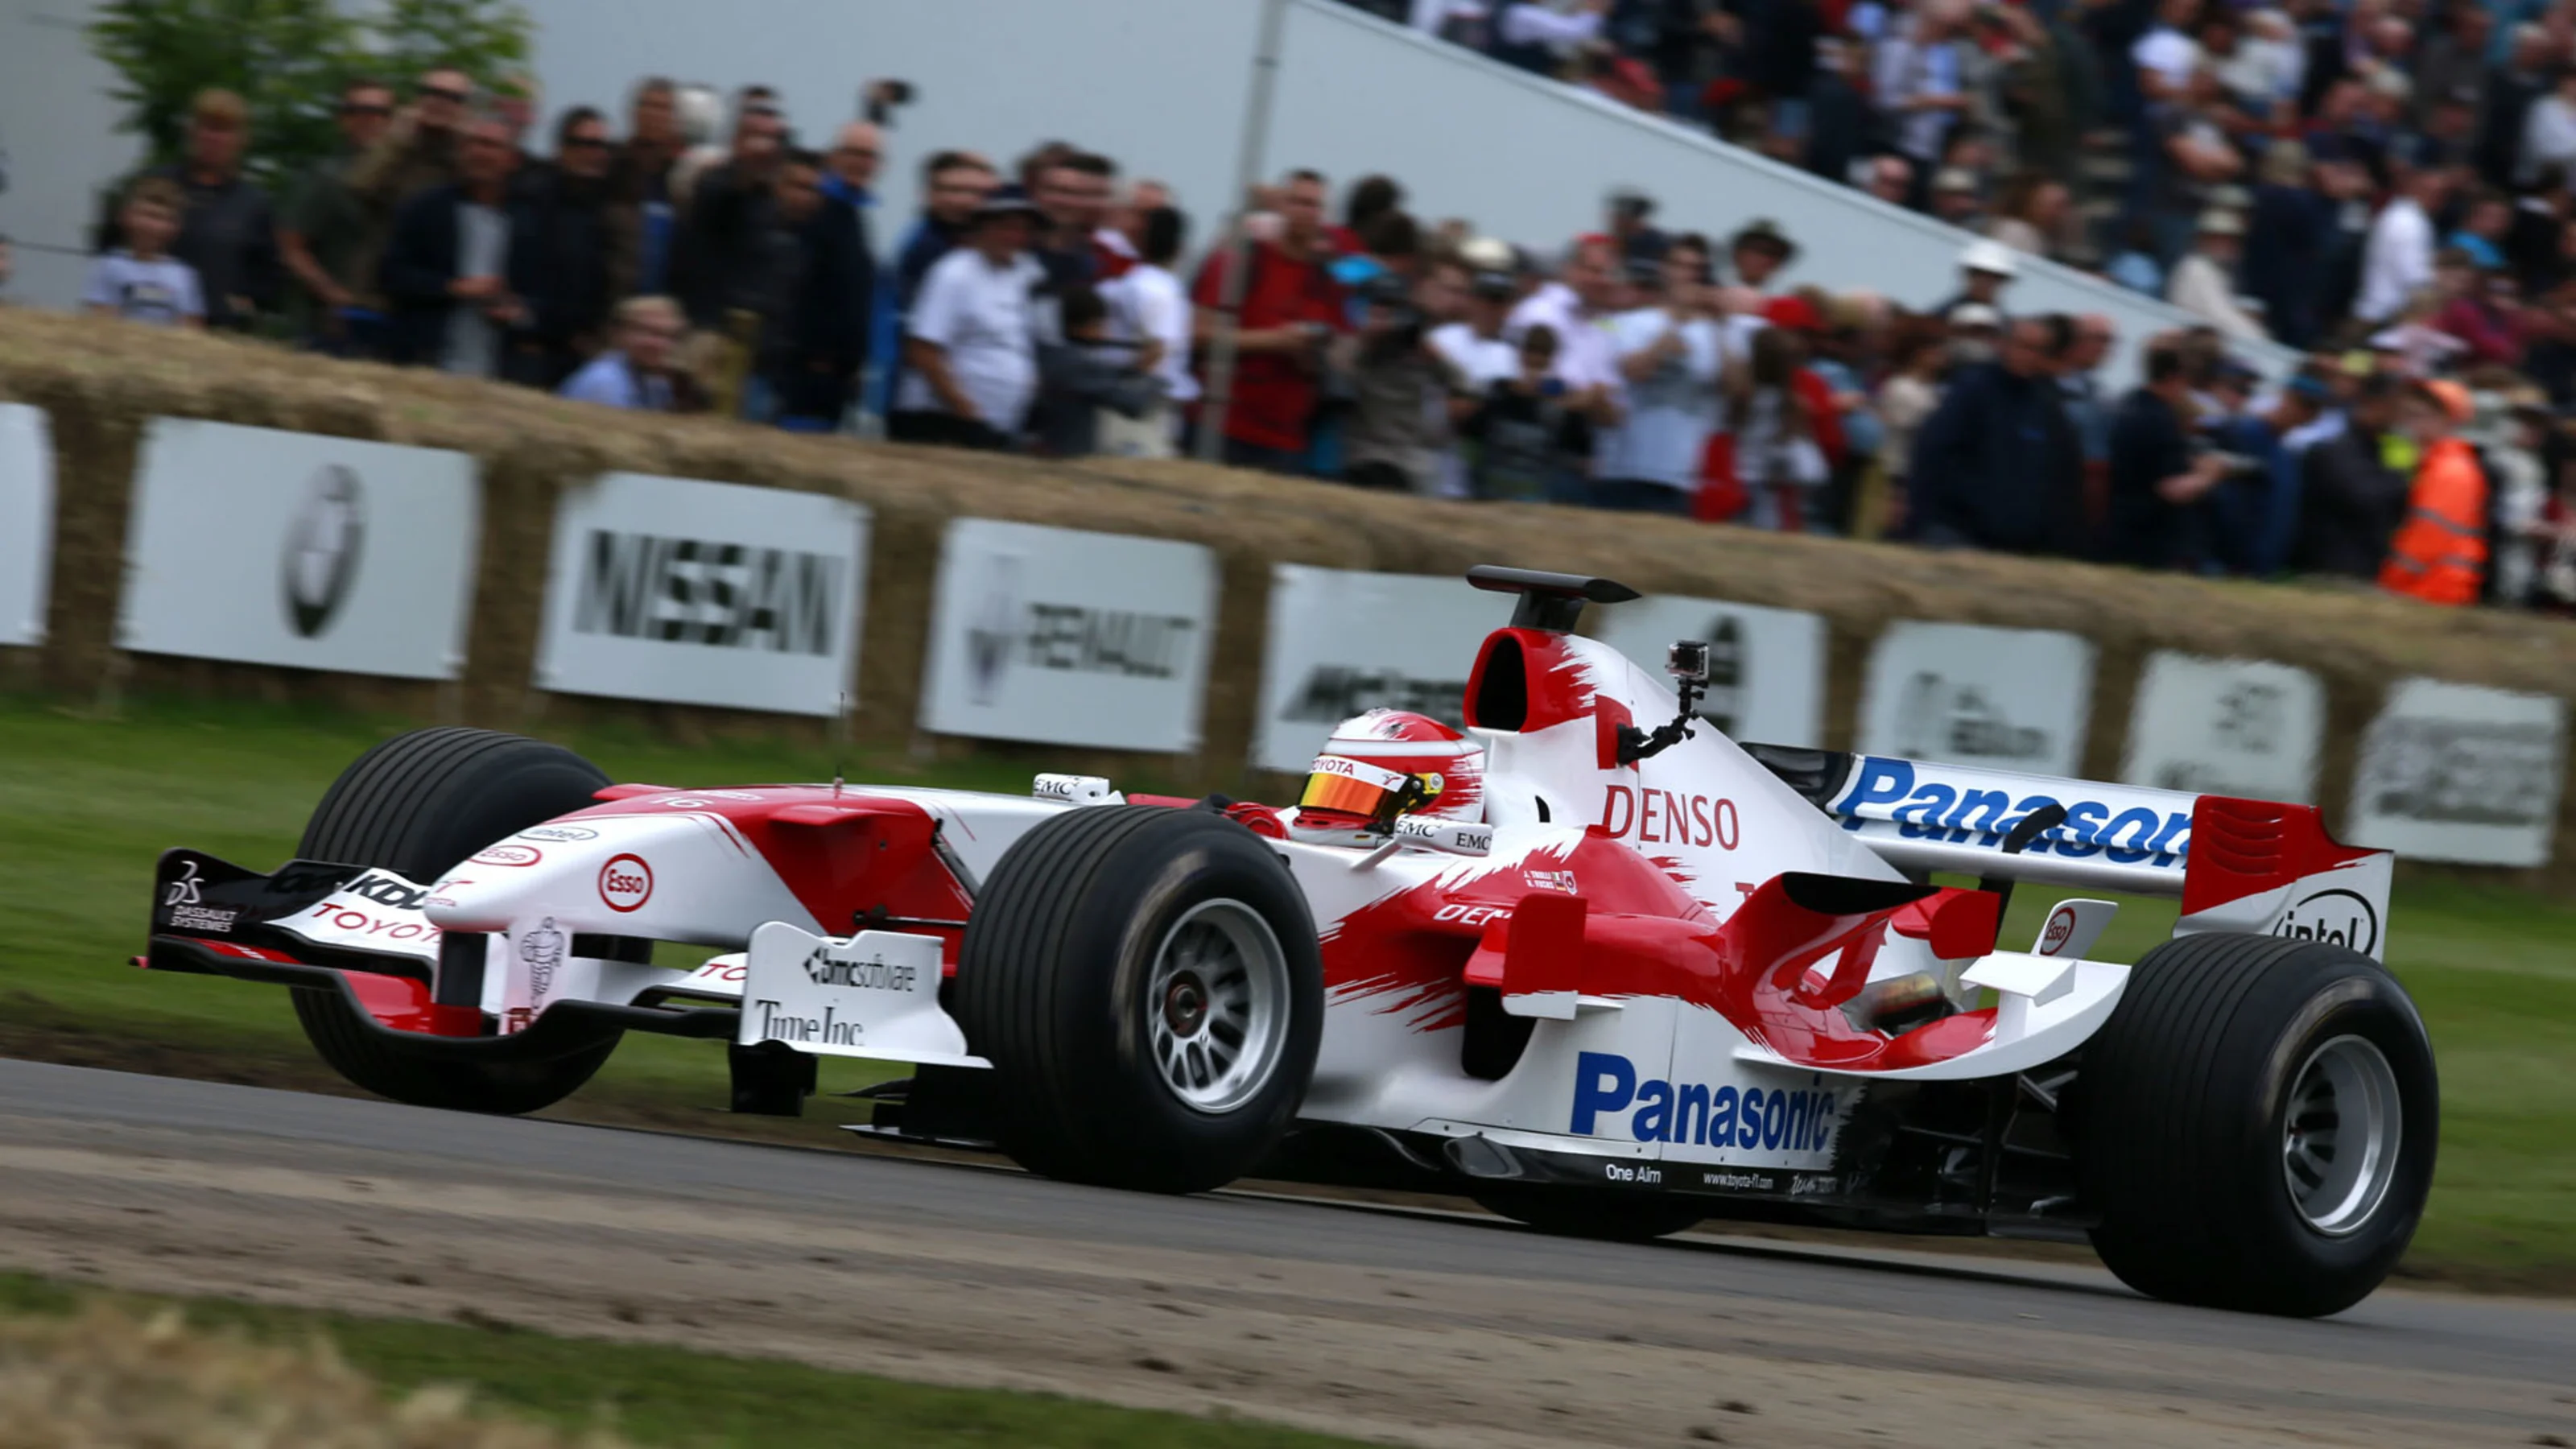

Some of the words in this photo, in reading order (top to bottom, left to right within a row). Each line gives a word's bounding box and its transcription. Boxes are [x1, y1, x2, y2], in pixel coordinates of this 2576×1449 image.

[573, 529, 842, 657] NISSAN
[1601, 784, 1739, 851] DENSO
[607, 869, 644, 894] Esso
[172, 905, 238, 922] DASSAULT
[312, 902, 443, 943] TOYOT
[2045, 922, 2068, 941] Esso
[756, 999, 820, 1042] Time
[1570, 1051, 1835, 1153] Panasonic
[1606, 1164, 1633, 1182] One
[1636, 1166, 1661, 1183] Aim
